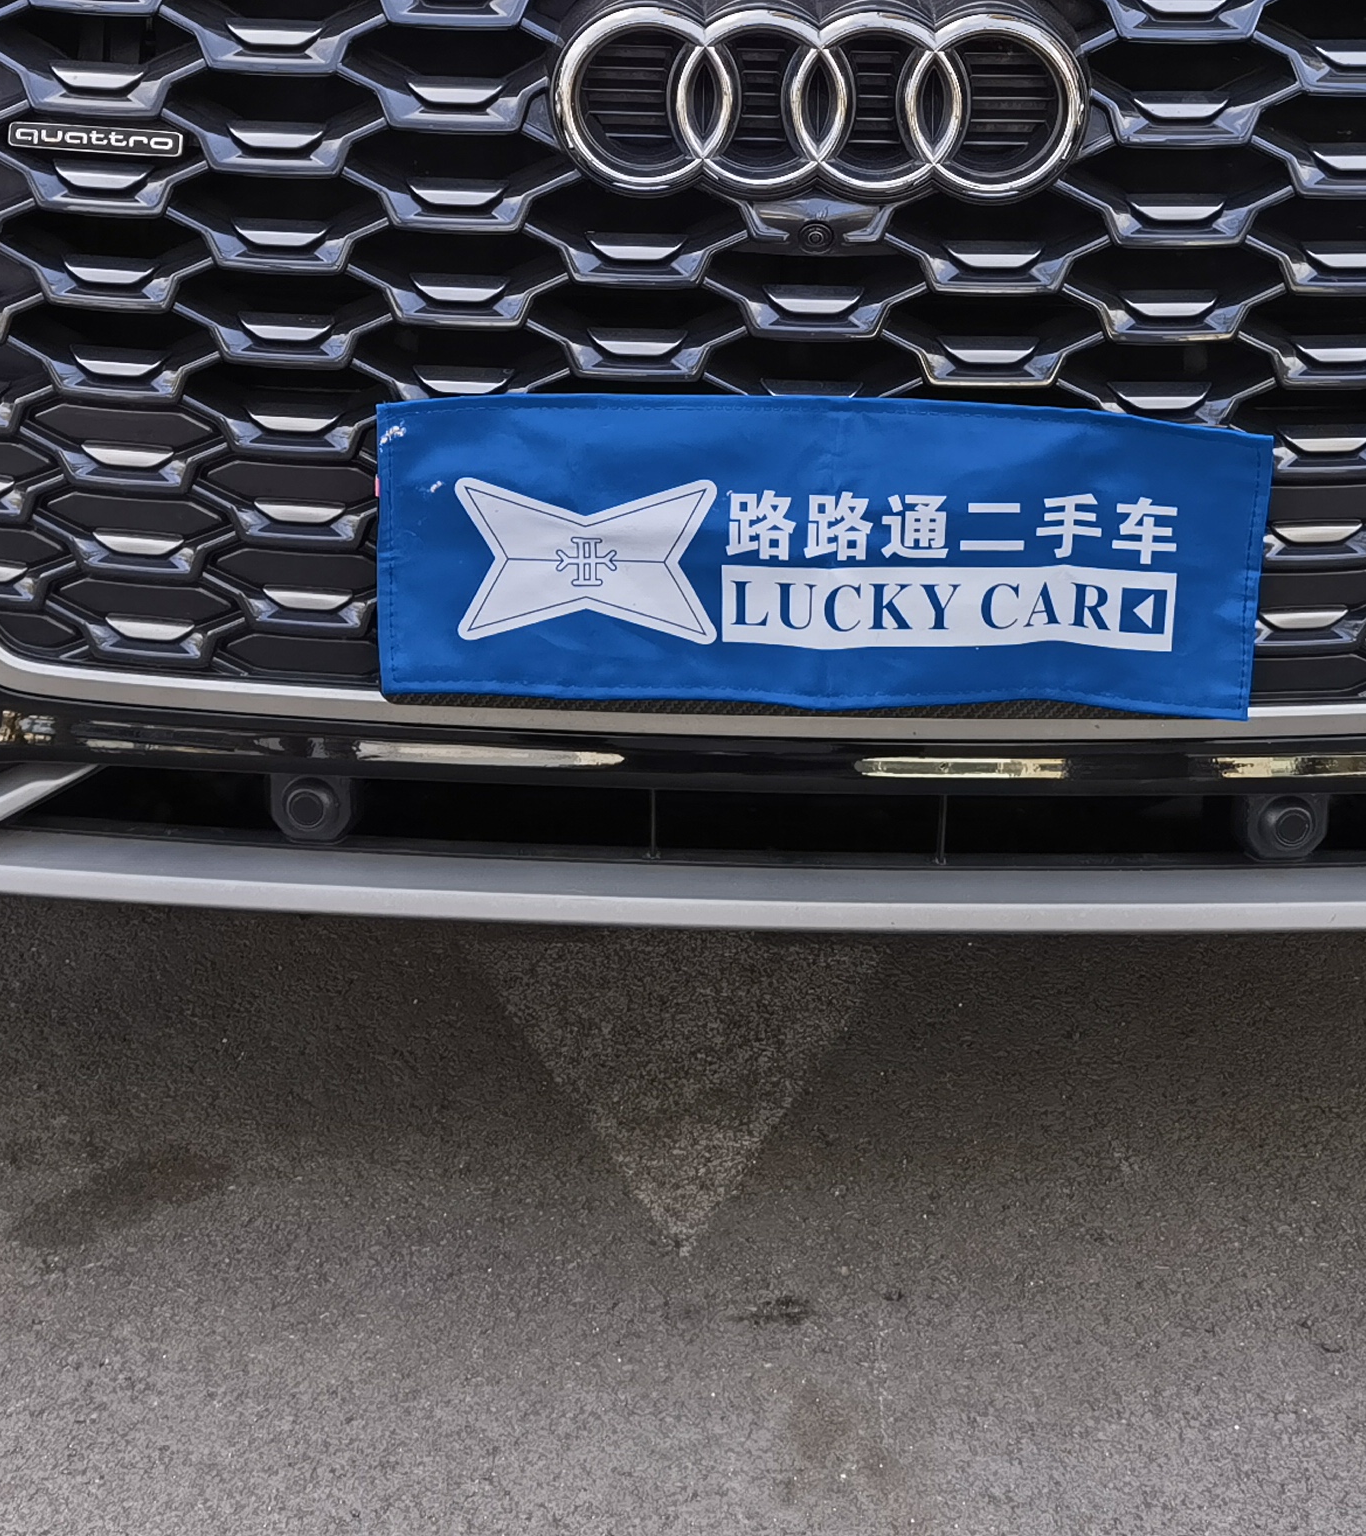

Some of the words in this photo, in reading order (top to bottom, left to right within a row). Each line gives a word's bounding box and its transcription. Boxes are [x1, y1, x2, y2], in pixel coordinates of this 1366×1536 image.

[15, 128, 173, 150] quattro
[725, 489, 1180, 565] 路路通二手车
[732, 580, 962, 632] LUCKY
[981, 581, 1113, 632] CAR
